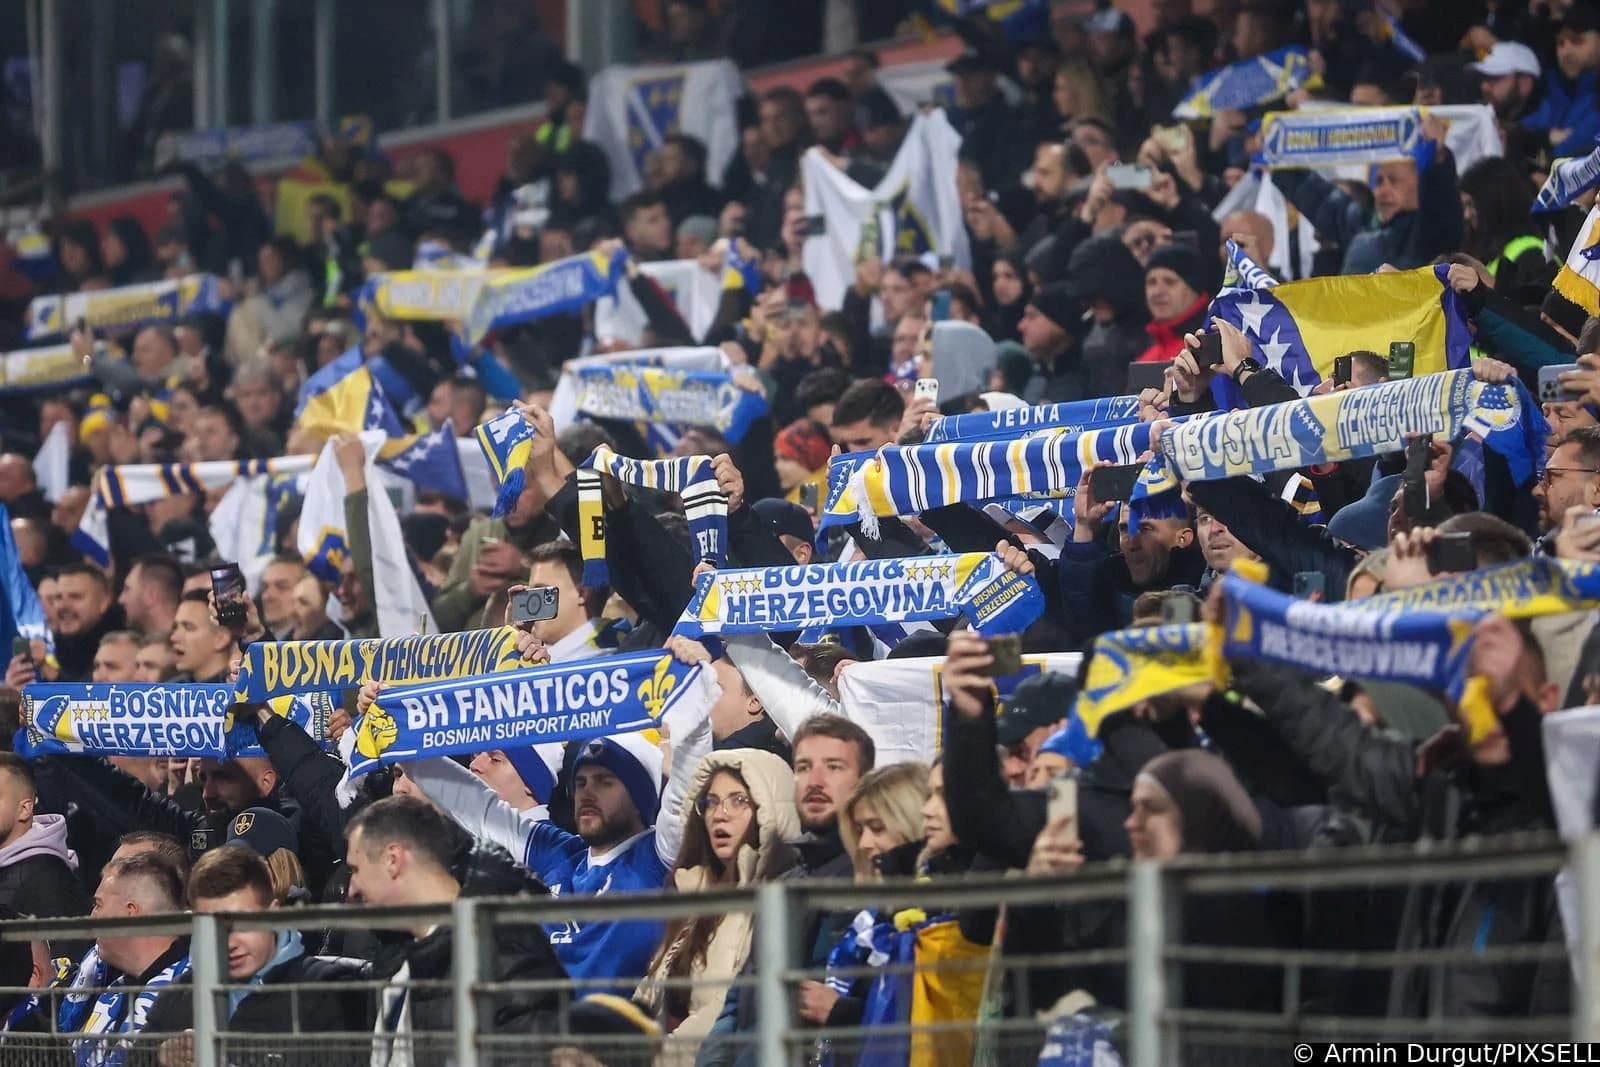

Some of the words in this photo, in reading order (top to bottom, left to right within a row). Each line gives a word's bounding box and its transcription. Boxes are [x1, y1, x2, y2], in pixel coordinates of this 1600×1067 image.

[991, 404, 1060, 429] JEDNA
[1180, 402, 1292, 471] BOSNA
[1335, 374, 1445, 450] HERCEGOVINA
[726, 581, 946, 624] HERZEGOVINA
[972, 581, 1002, 607] BOSNIA
[976, 579, 1029, 620] HERZEGOVINA
[263, 641, 356, 692] BOSNA
[402, 693, 449, 730] BH
[454, 668, 630, 724] FANATICOS
[77, 722, 221, 749] HERZEGOV
[422, 725, 491, 749] BOSNIAN
[495, 715, 570, 740] SUPPORT
[568, 708, 613, 731] ARMY
